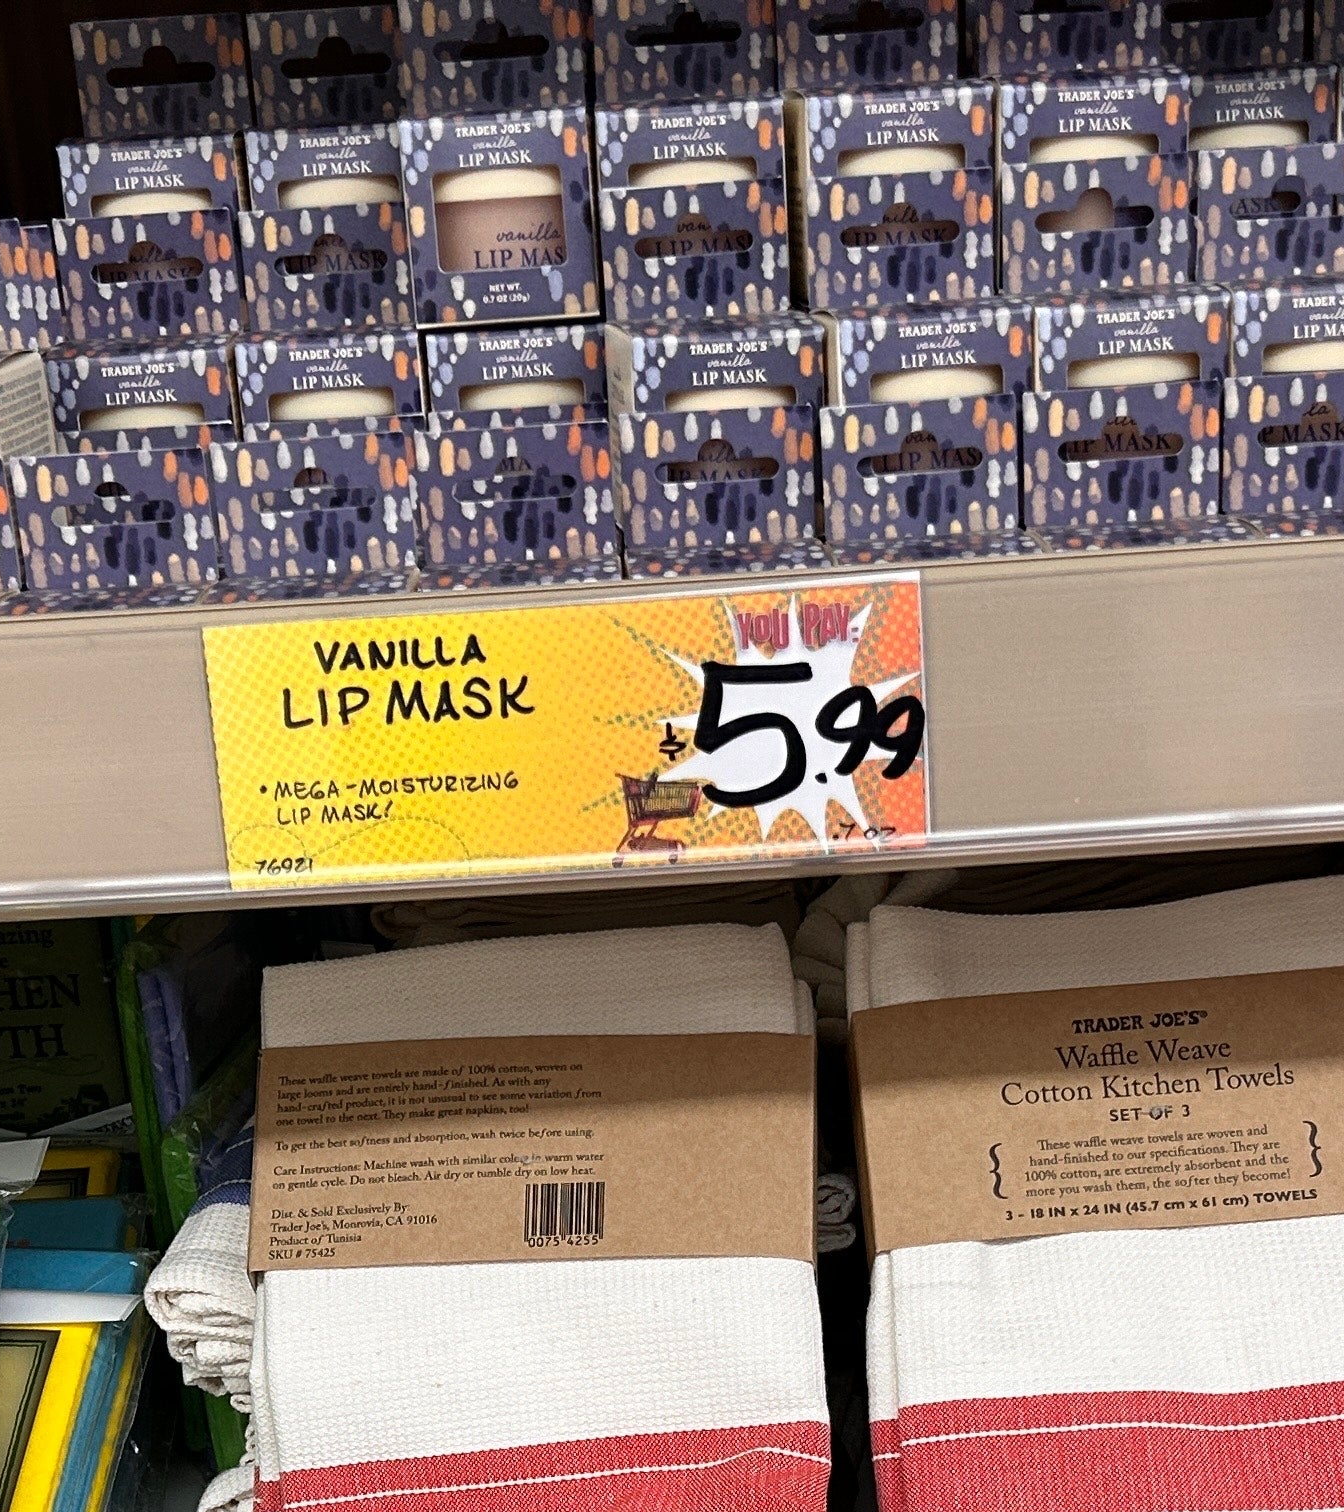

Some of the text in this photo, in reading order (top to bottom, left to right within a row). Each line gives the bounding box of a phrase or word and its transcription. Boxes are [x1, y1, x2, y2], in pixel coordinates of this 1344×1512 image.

[455, 125, 497, 137] TRADER
[473, 135, 517, 149] vanilla
[459, 150, 532, 168] LIP MASK
[497, 222, 561, 242] vanilla
[474, 250, 513, 269] LIP
[732, 609, 791, 652] YOU
[314, 634, 486, 674] VANILLA
[282, 674, 535, 729] LIP MASK
[659, 661, 926, 806] $5.99
[276, 799, 392, 825] LIP MASK!
[1072, 1014, 1145, 1034] TRADER
[1055, 1040, 1232, 1069] Waffle Weave
[1001, 1063, 1294, 1106] Cotton Kitchen Towels
[1109, 1108, 1143, 1122] SET
[1182, 1105, 1190, 1118] 3
